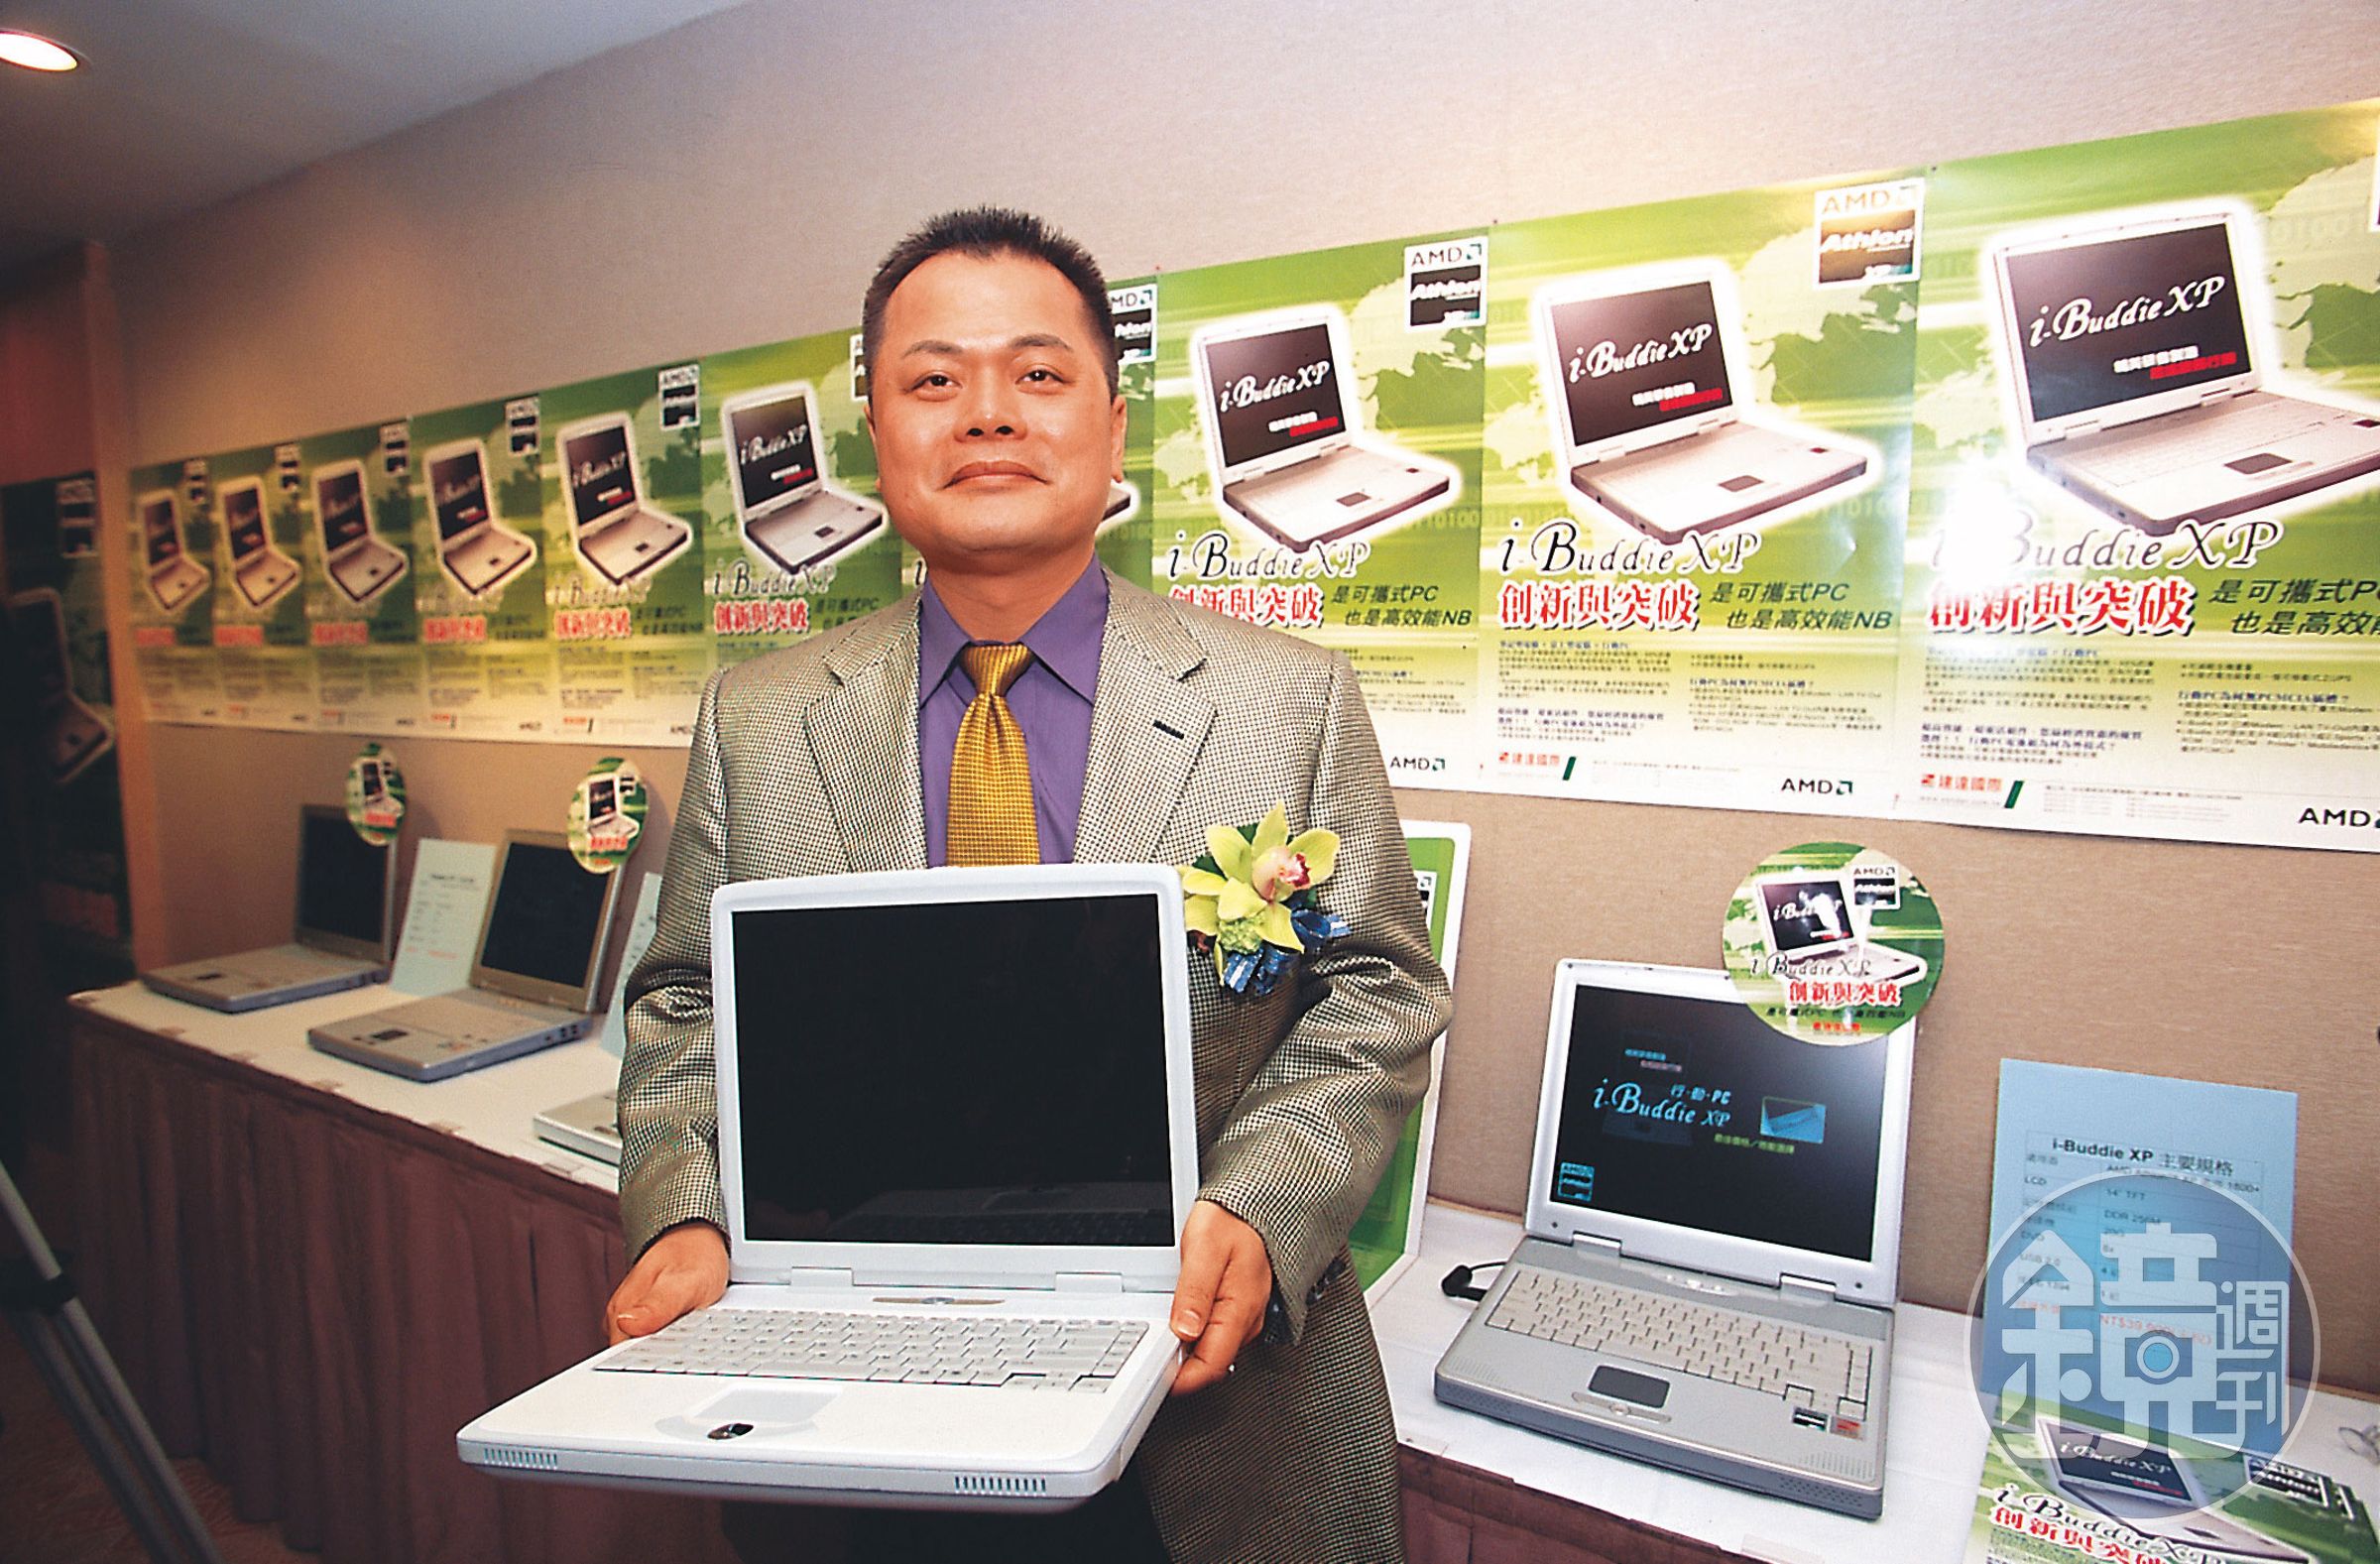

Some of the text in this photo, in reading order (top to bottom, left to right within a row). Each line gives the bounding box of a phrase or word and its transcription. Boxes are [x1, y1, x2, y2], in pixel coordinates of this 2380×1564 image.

[1823, 189, 1890, 214] AMD
[1412, 247, 1463, 266] AMD
[1112, 293, 1137, 306] MD
[2164, 276, 2226, 316] XP
[1669, 323, 1713, 356] XP
[1296, 360, 1331, 389] XP
[1683, 533, 1760, 571] XP
[2169, 520, 2281, 568] XP
[1307, 541, 1368, 577] XP
[1711, 582, 1850, 604] 是可攜式PC
[2208, 578, 2380, 603] 是可攜式P
[1345, 608, 1473, 628] 也是高效能NB
[1500, 583, 1699, 630] 創新與突破
[1929, 579, 2195, 634] 創新與突破
[1726, 609, 1893, 631] 也是高效能NB
[1390, 756, 1430, 771] AMD
[1782, 778, 1834, 794] AMD
[2298, 807, 2371, 827] AMD
[1789, 980, 1899, 1005] 創新與突破
[1701, 1109, 1731, 1128] XP
[2053, 1139, 2124, 1160] i-Buddie
[2130, 1148, 2154, 1162] XP
